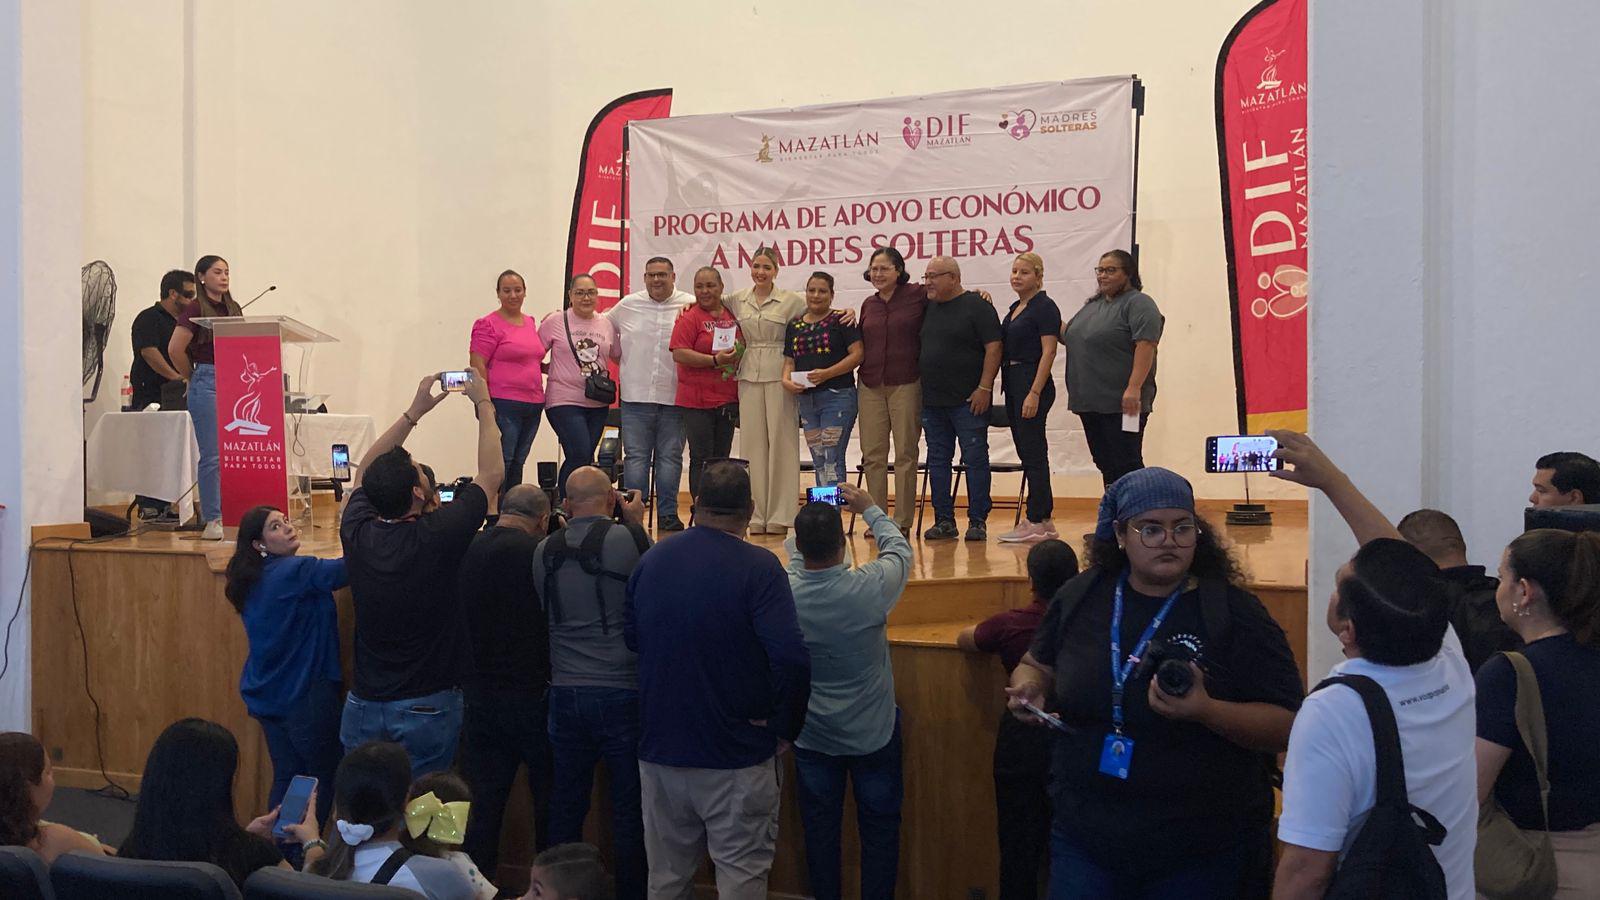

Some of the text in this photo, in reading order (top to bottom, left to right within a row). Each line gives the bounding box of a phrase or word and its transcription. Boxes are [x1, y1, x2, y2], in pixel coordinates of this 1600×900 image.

[1240, 81, 1307, 109] MAZATLÁN
[926, 113, 971, 138] DIF
[1040, 111, 1097, 125] MADRES
[1040, 121, 1098, 134] SOLTERAS
[779, 130, 879, 154] MAZATLÁN
[1242, 140, 1297, 256] DIF
[654, 185, 1101, 237] PROGRAMA DE APOYO ECONÓMICO
[711, 243, 730, 270] A
[870, 225, 1034, 261] SOLTERAS
[223, 440, 281, 451] MAZATLÁN
